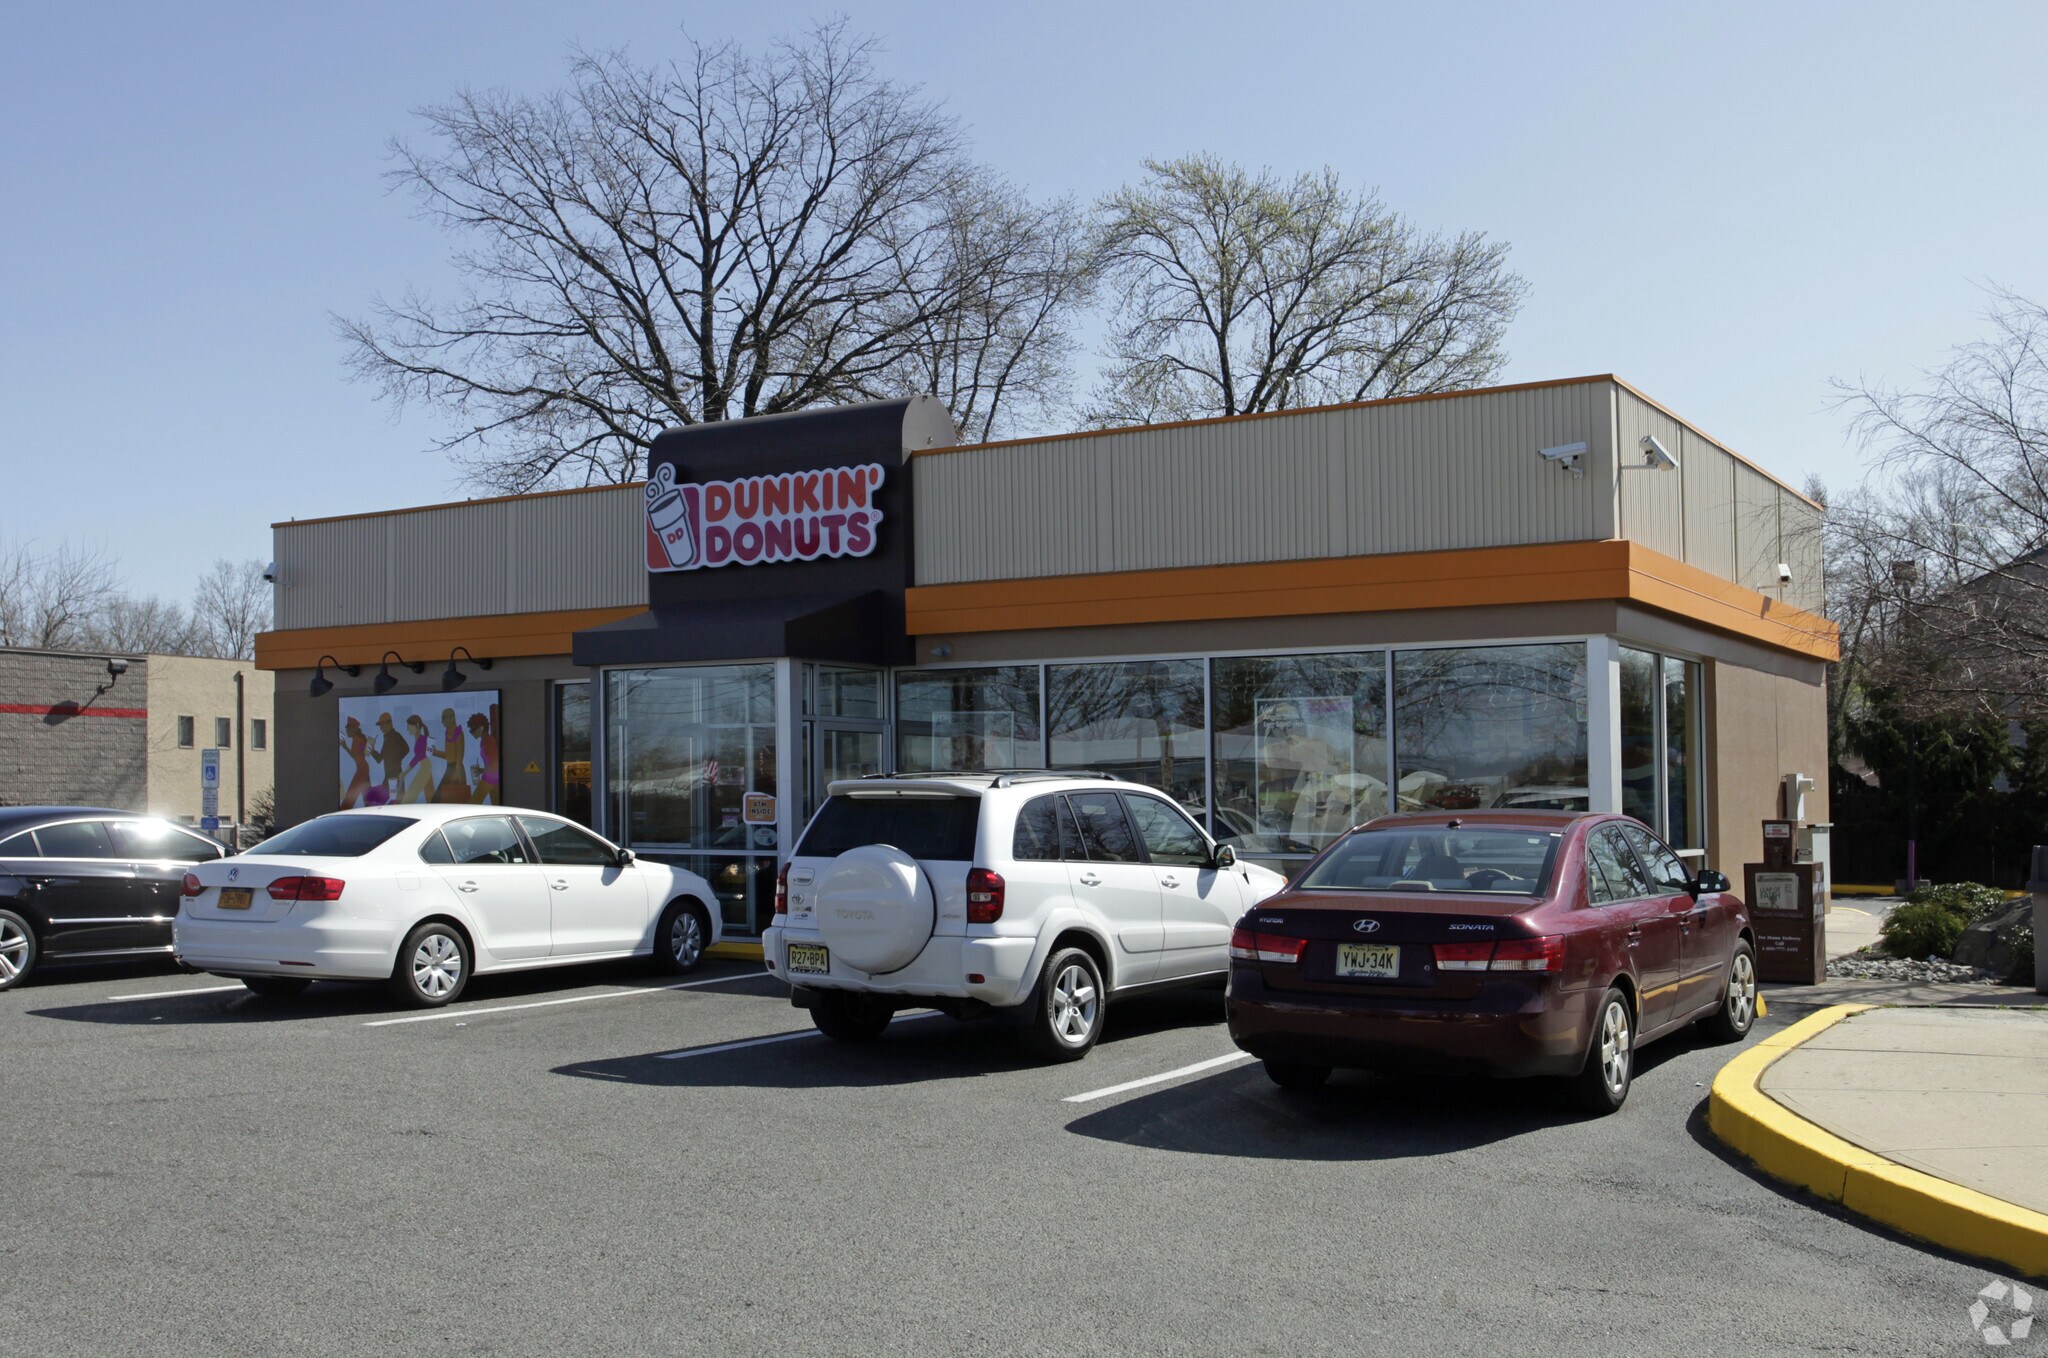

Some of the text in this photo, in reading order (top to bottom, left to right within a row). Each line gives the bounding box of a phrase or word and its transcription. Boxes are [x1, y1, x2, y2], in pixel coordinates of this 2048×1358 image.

[705, 467, 879, 522] DUNKIN'
[666, 527, 684, 545] DD
[705, 512, 872, 563] DONUTS
[835, 909, 874, 920] TOYOTA
